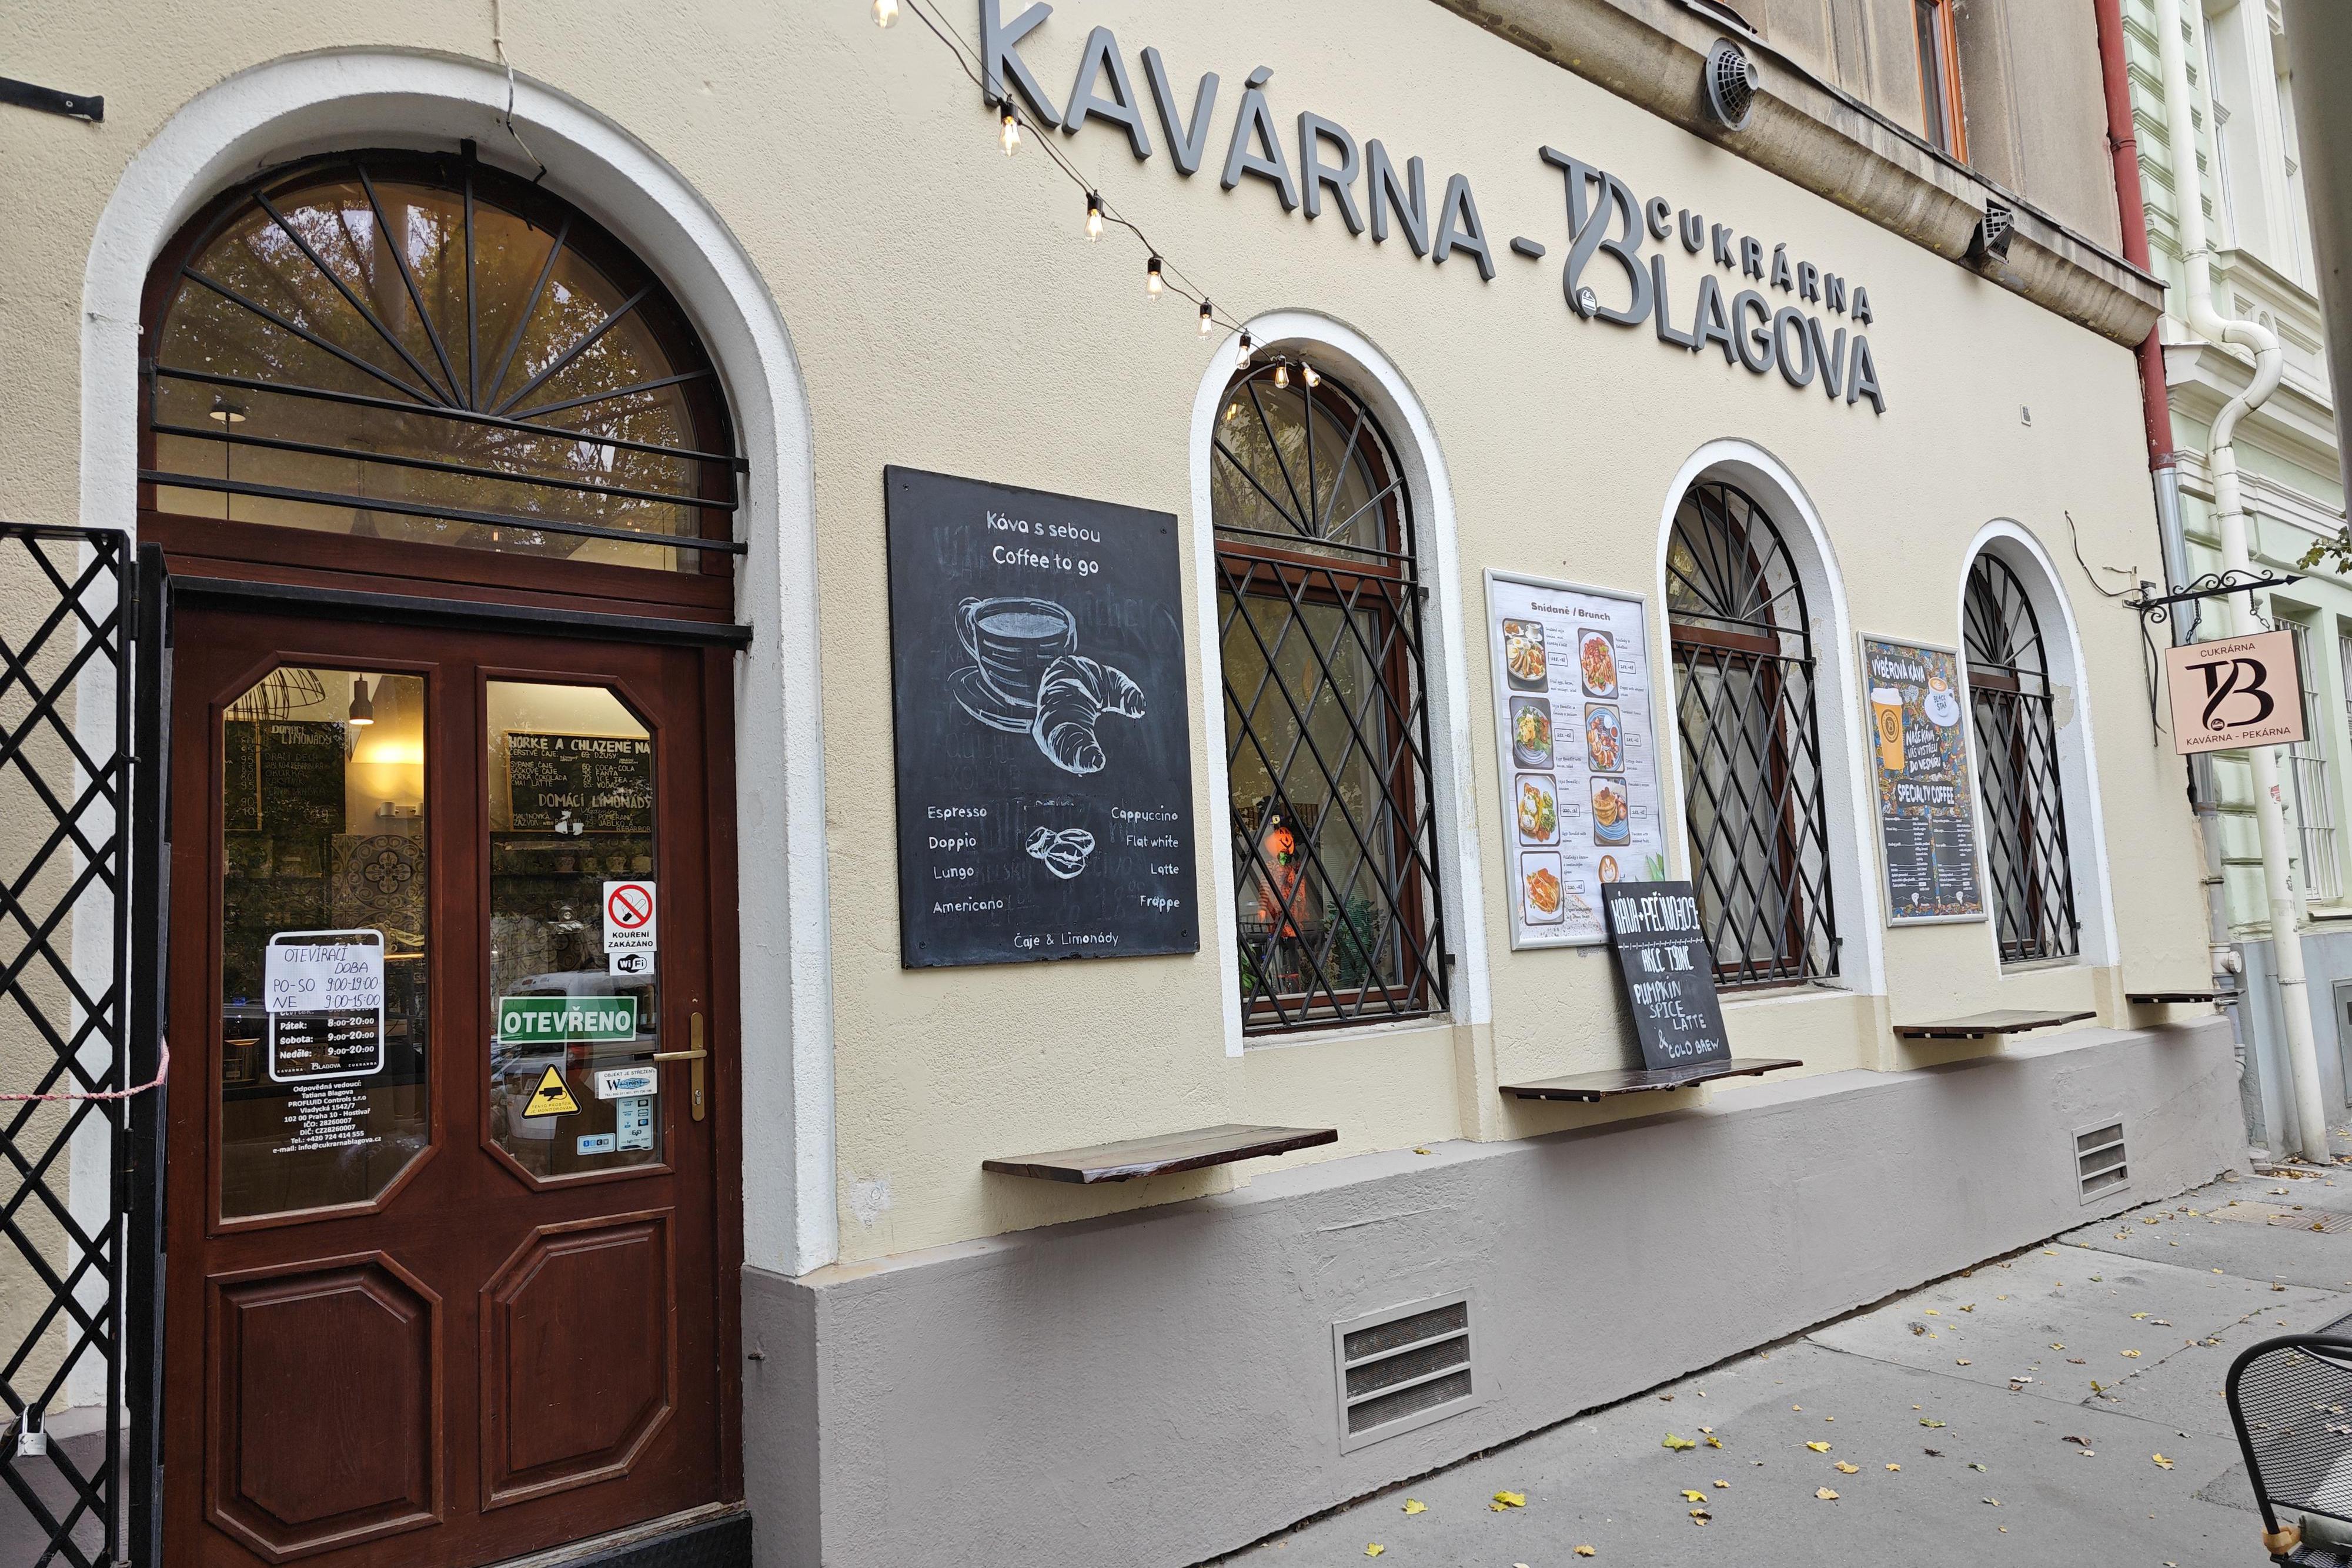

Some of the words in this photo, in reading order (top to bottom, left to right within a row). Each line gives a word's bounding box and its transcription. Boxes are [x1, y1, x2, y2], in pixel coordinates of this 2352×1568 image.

[978, 0, 1496, 282] KAVÁRNA
[1646, 196, 1874, 326] CUKRÁRNA
[987, 510, 1029, 534] Káva
[1034, 523, 1044, 537] s
[1048, 522, 1101, 543] sebou
[993, 546, 1050, 569] Coffee
[1054, 556, 1072, 570] to
[1078, 561, 1100, 576] go
[1531, 602, 1570, 615] Snídaně
[1573, 607, 1576, 616] /
[1578, 609, 1611, 621] Brunch
[2200, 643, 2256, 657] CUKRÁRNA
[1908, 660, 1926, 683] KÁVA
[1906, 724, 1922, 746] NAŠE
[1922, 724, 1935, 743] KÁVA
[2186, 734, 2233, 745] KAVÁRNA
[2243, 727, 2291, 739] PEKÁRNA
[555, 738, 564, 750] A
[570, 739, 632, 753] CHLAZENÉ
[1907, 745, 1917, 758] VÁS
[1909, 760, 1918, 773] DO
[1897, 783, 1930, 804] SPECIALTY
[1931, 785, 1955, 804] COFFEE
[927, 805, 988, 821] Espresso
[1111, 805, 1179, 823] Cappuccino
[929, 832, 977, 852] Doppio
[1127, 835, 1148, 847] Flat
[1151, 835, 1179, 848] white
[934, 865, 975, 881] Lungo
[1151, 862, 1180, 875] Latte
[933, 896, 1004, 914] Americano
[1014, 932, 1040, 950] Čaje
[1047, 934, 1054, 945] &
[1061, 932, 1118, 947] Limonády
[285, 944, 348, 962] OTEVÍRACÍ
[1642, 948, 1665, 973] AKCE
[335, 962, 368, 974] DOBA
[274, 978, 315, 992] PO-SO
[273, 996, 298, 1008] NE
[1649, 1000, 1686, 1019] SPICE
[280, 1021, 308, 1030] Pátek:
[328, 1017, 375, 1027] 8:00-20:00
[504, 1005, 632, 1034] OTEVŘENO
[1673, 1013, 1706, 1031] LATTE
[280, 1035, 313, 1045] Sobota:
[328, 1031, 375, 1041] 9:00-20:00
[1658, 1029, 1668, 1049] &
[1668, 1040, 1692, 1059] COLD
[1695, 1038, 1720, 1055] BREW
[280, 1048, 312, 1059] Neděle:
[328, 1045, 375, 1055] 9:00-20:00
[293, 1084, 332, 1092] Odpovědná
[333, 1080, 362, 1088] vedoucí:
[343, 1108, 370, 1116] Hostivař
[303, 1120, 318, 1128] IČO:
[319, 1118, 352, 1126] 28260007
[315, 1125, 356, 1134] CZ28260007
[298, 1136, 382, 1151] info@cukrarnablagova.cz
